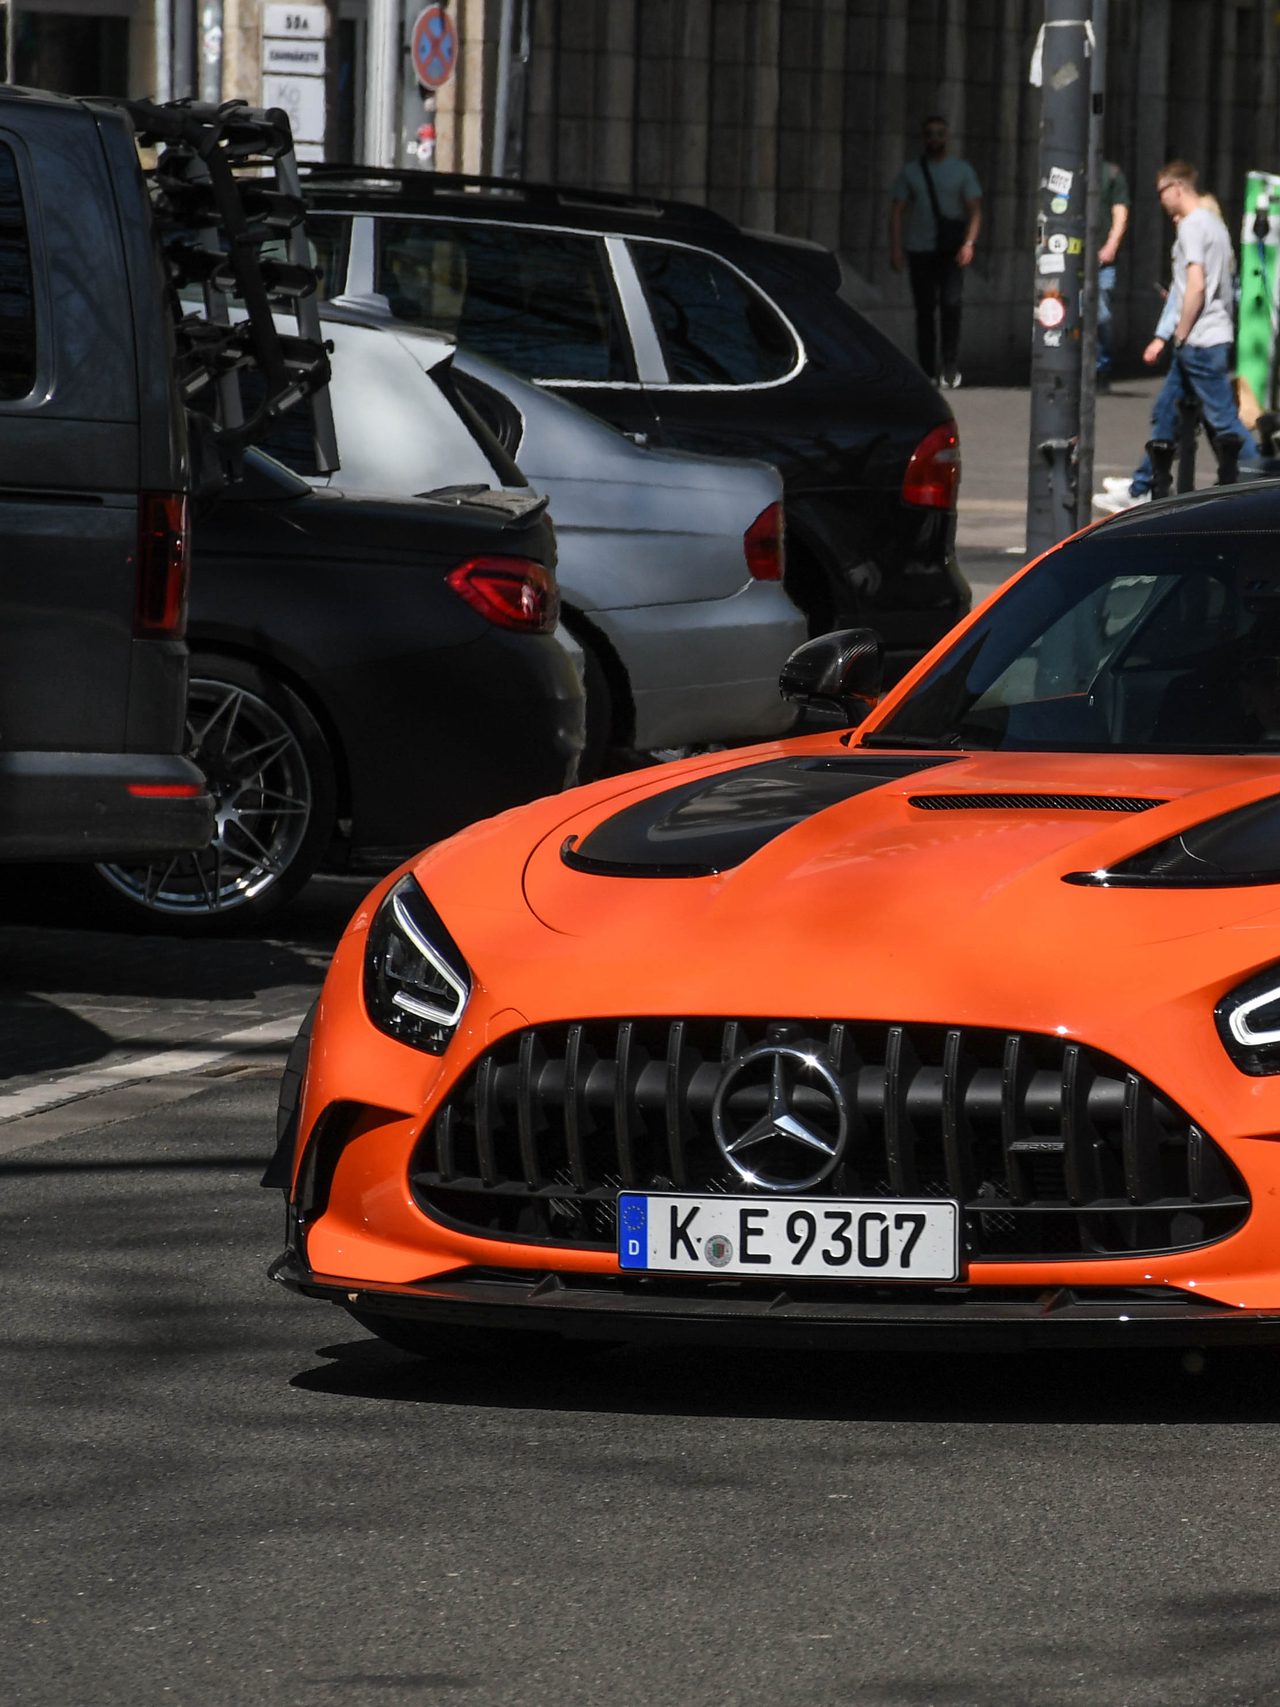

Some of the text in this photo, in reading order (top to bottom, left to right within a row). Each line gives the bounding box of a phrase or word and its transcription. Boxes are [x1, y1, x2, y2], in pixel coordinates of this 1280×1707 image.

[628, 1240, 640, 1256] D
[670, 1205, 926, 1269] K E 9307
